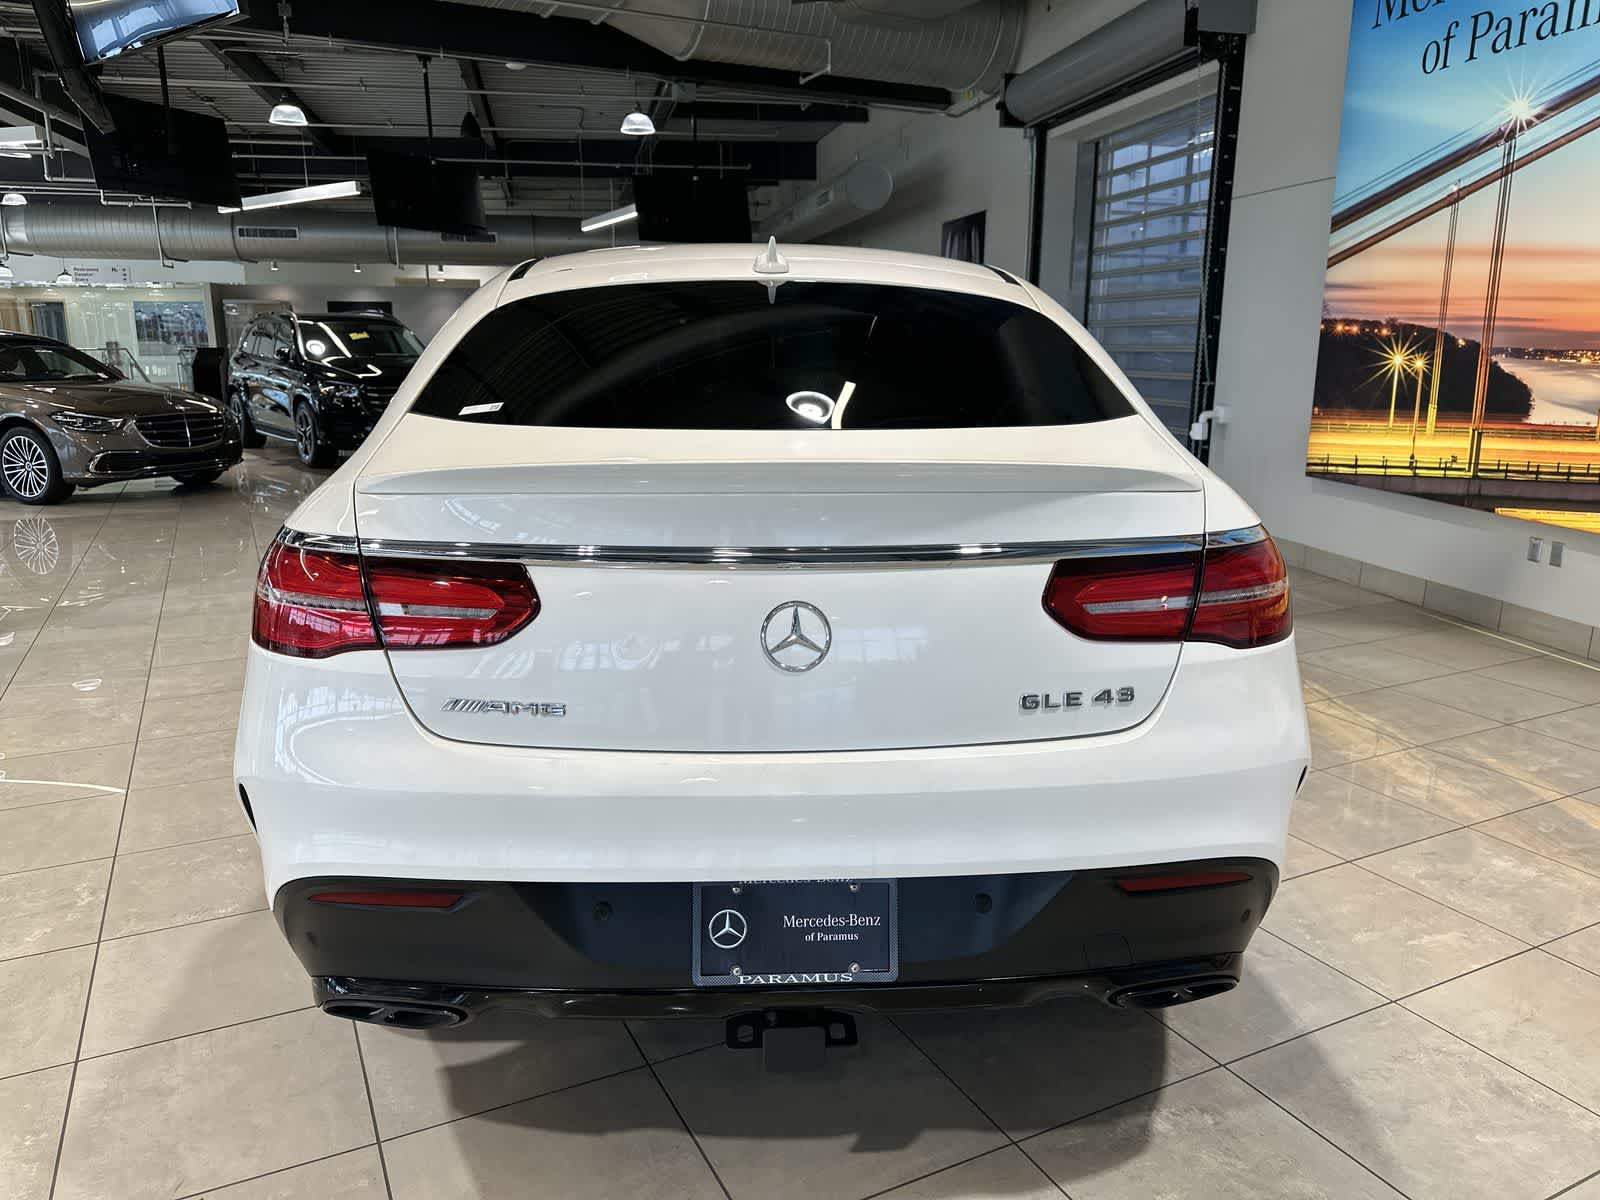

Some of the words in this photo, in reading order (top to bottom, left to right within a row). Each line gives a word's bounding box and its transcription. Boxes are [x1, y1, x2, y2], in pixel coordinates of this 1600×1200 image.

[1421, 20, 1460, 74] of
[1020, 691, 1083, 710] GLE
[1092, 686, 1135, 704] 43
[783, 913, 881, 928] Mercedes-Benz
[805, 932, 815, 941] of
[817, 932, 859, 941] Paramus
[738, 973, 853, 984] PARAMUS
